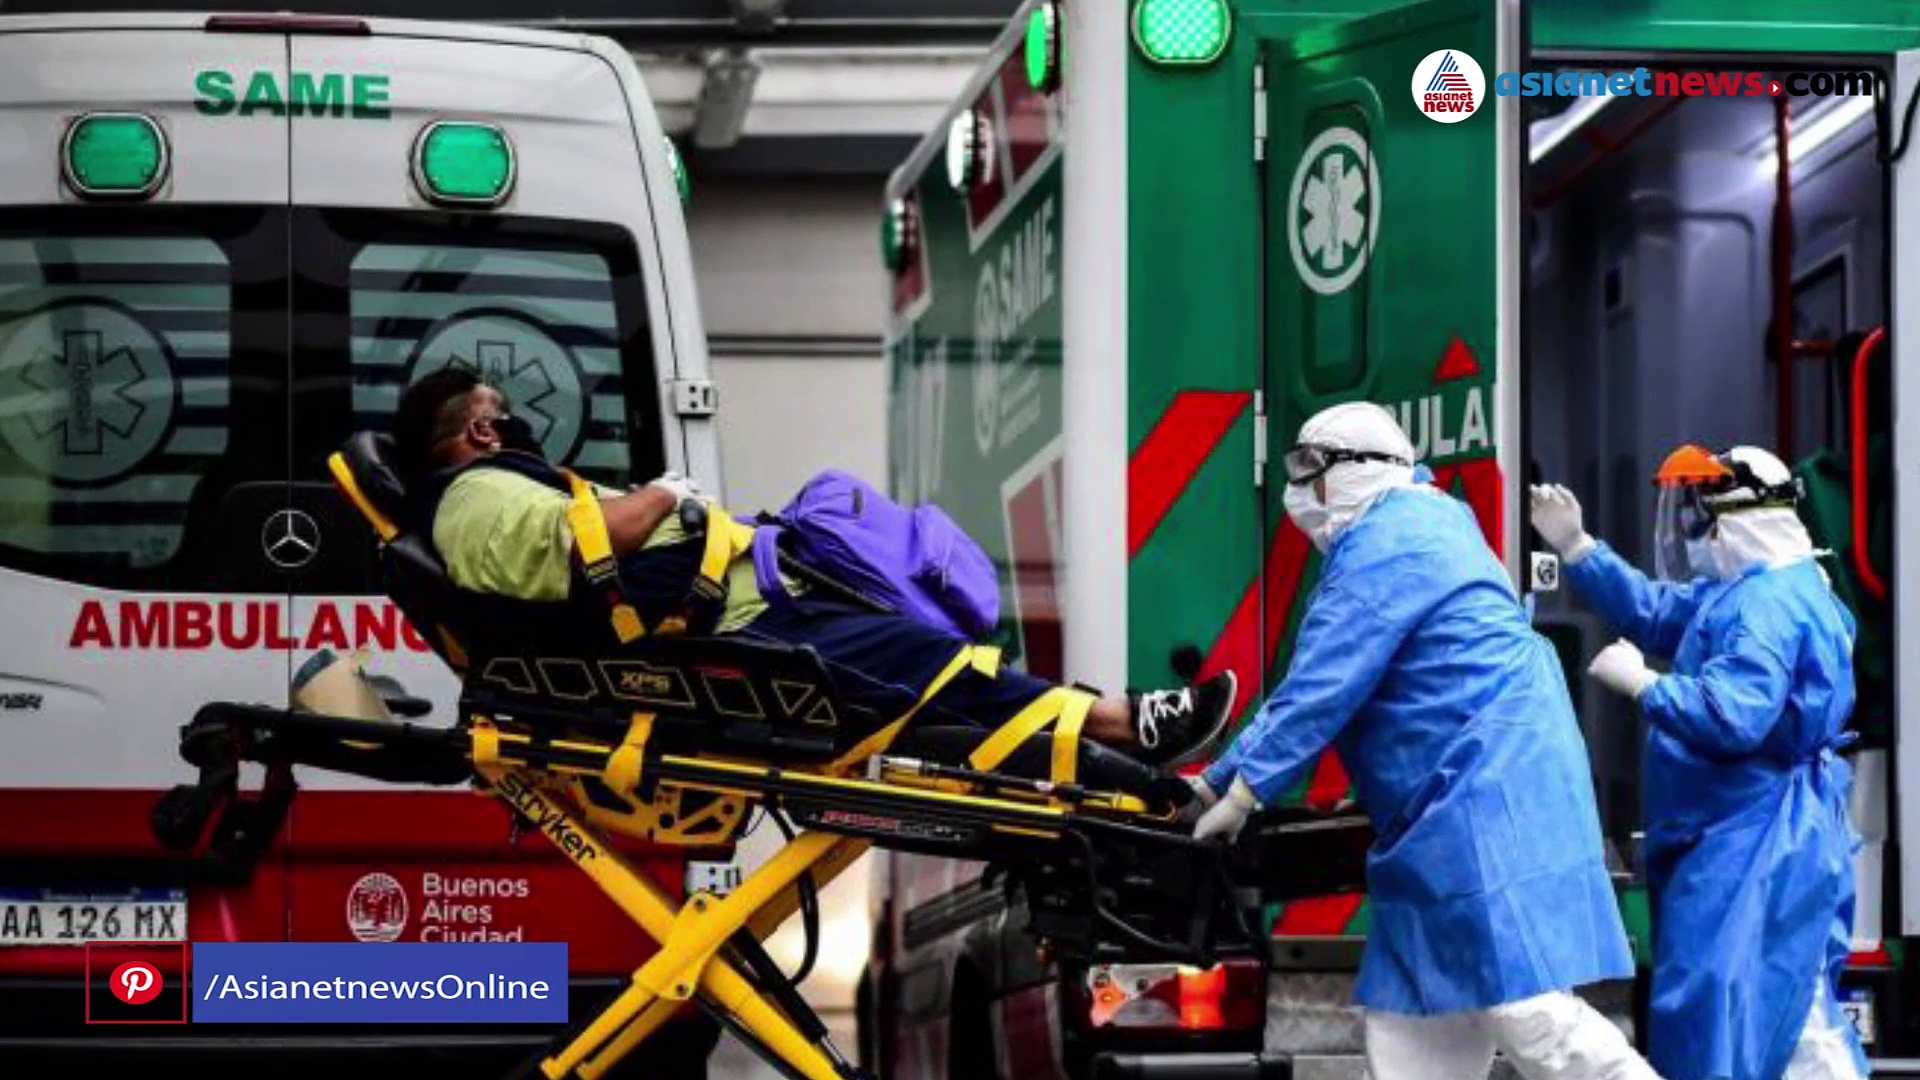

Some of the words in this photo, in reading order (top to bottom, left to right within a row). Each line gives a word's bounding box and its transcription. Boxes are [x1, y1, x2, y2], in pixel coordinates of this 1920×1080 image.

[193, 70, 391, 119] SAME
[1000, 194, 1054, 342] SAME
[498, 771, 597, 862] stryker
[422, 871, 530, 898] Buenos
[2, 904, 43, 938] AA
[57, 904, 122, 939] 126
[134, 904, 176, 938] MX
[420, 899, 493, 924] Aires
[420, 925, 524, 943] Ciudad
